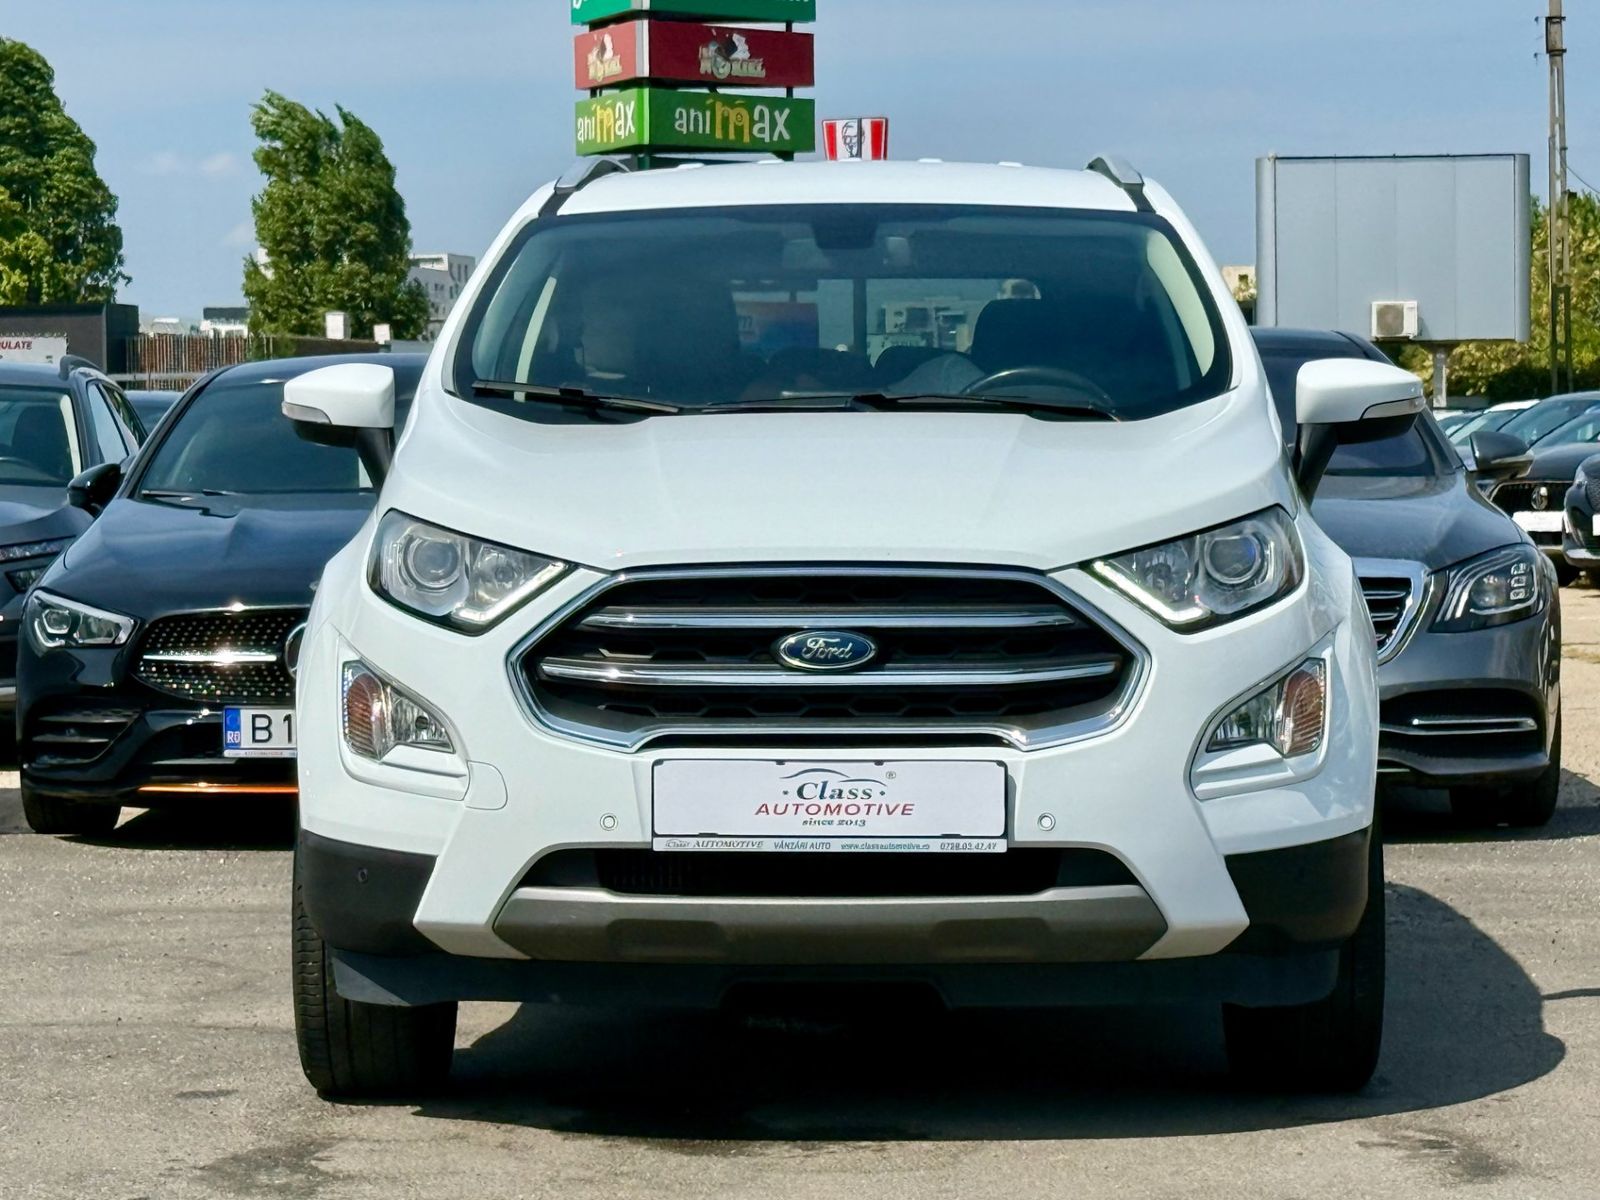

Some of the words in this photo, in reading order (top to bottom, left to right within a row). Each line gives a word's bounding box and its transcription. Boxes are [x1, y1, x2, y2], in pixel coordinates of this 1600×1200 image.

[577, 99, 636, 144] animax
[674, 98, 792, 144] animax
[0, 341, 33, 350] ULATE
[801, 637, 853, 660] Ford
[227, 731, 241, 743] RO
[796, 781, 873, 800] Class
[755, 803, 915, 816] AUTOMOTIVE
[802, 817, 835, 827] since
[837, 818, 866, 827] 2013
[693, 840, 764, 848] AUTOMOTIVE
[809, 841, 831, 850] AUTO
